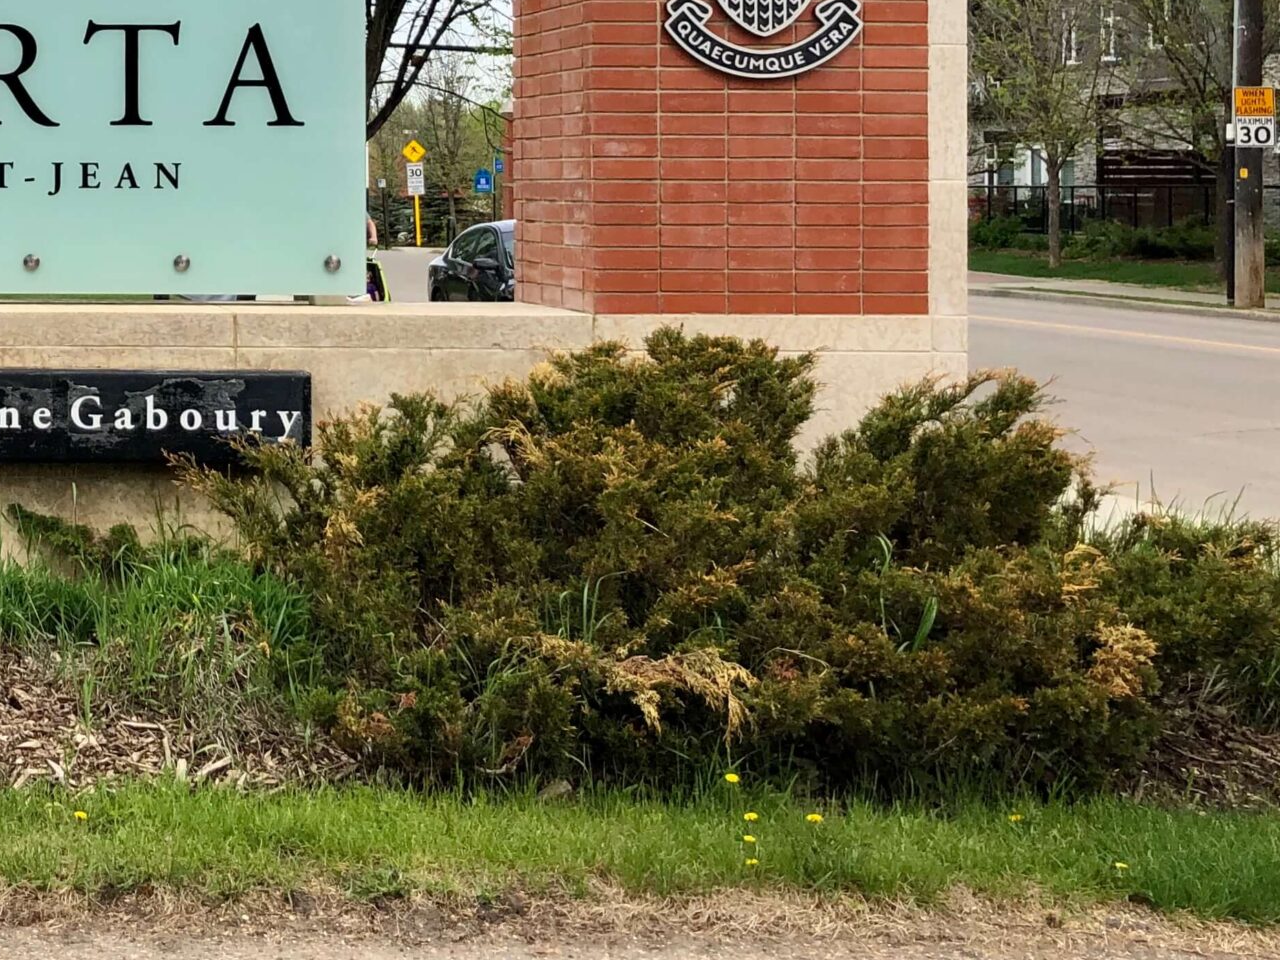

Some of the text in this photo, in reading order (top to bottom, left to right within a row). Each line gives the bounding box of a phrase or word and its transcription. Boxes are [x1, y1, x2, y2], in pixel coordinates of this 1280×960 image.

[677, 21, 853, 72] QUAECUMQUE VERA
[1236, 106, 1273, 115] FLASHING
[1237, 117, 1273, 125] MAXIMUM
[1239, 126, 1272, 144] 30
[408, 168, 422, 178] 30
[70, 395, 301, 443] Gaboury
